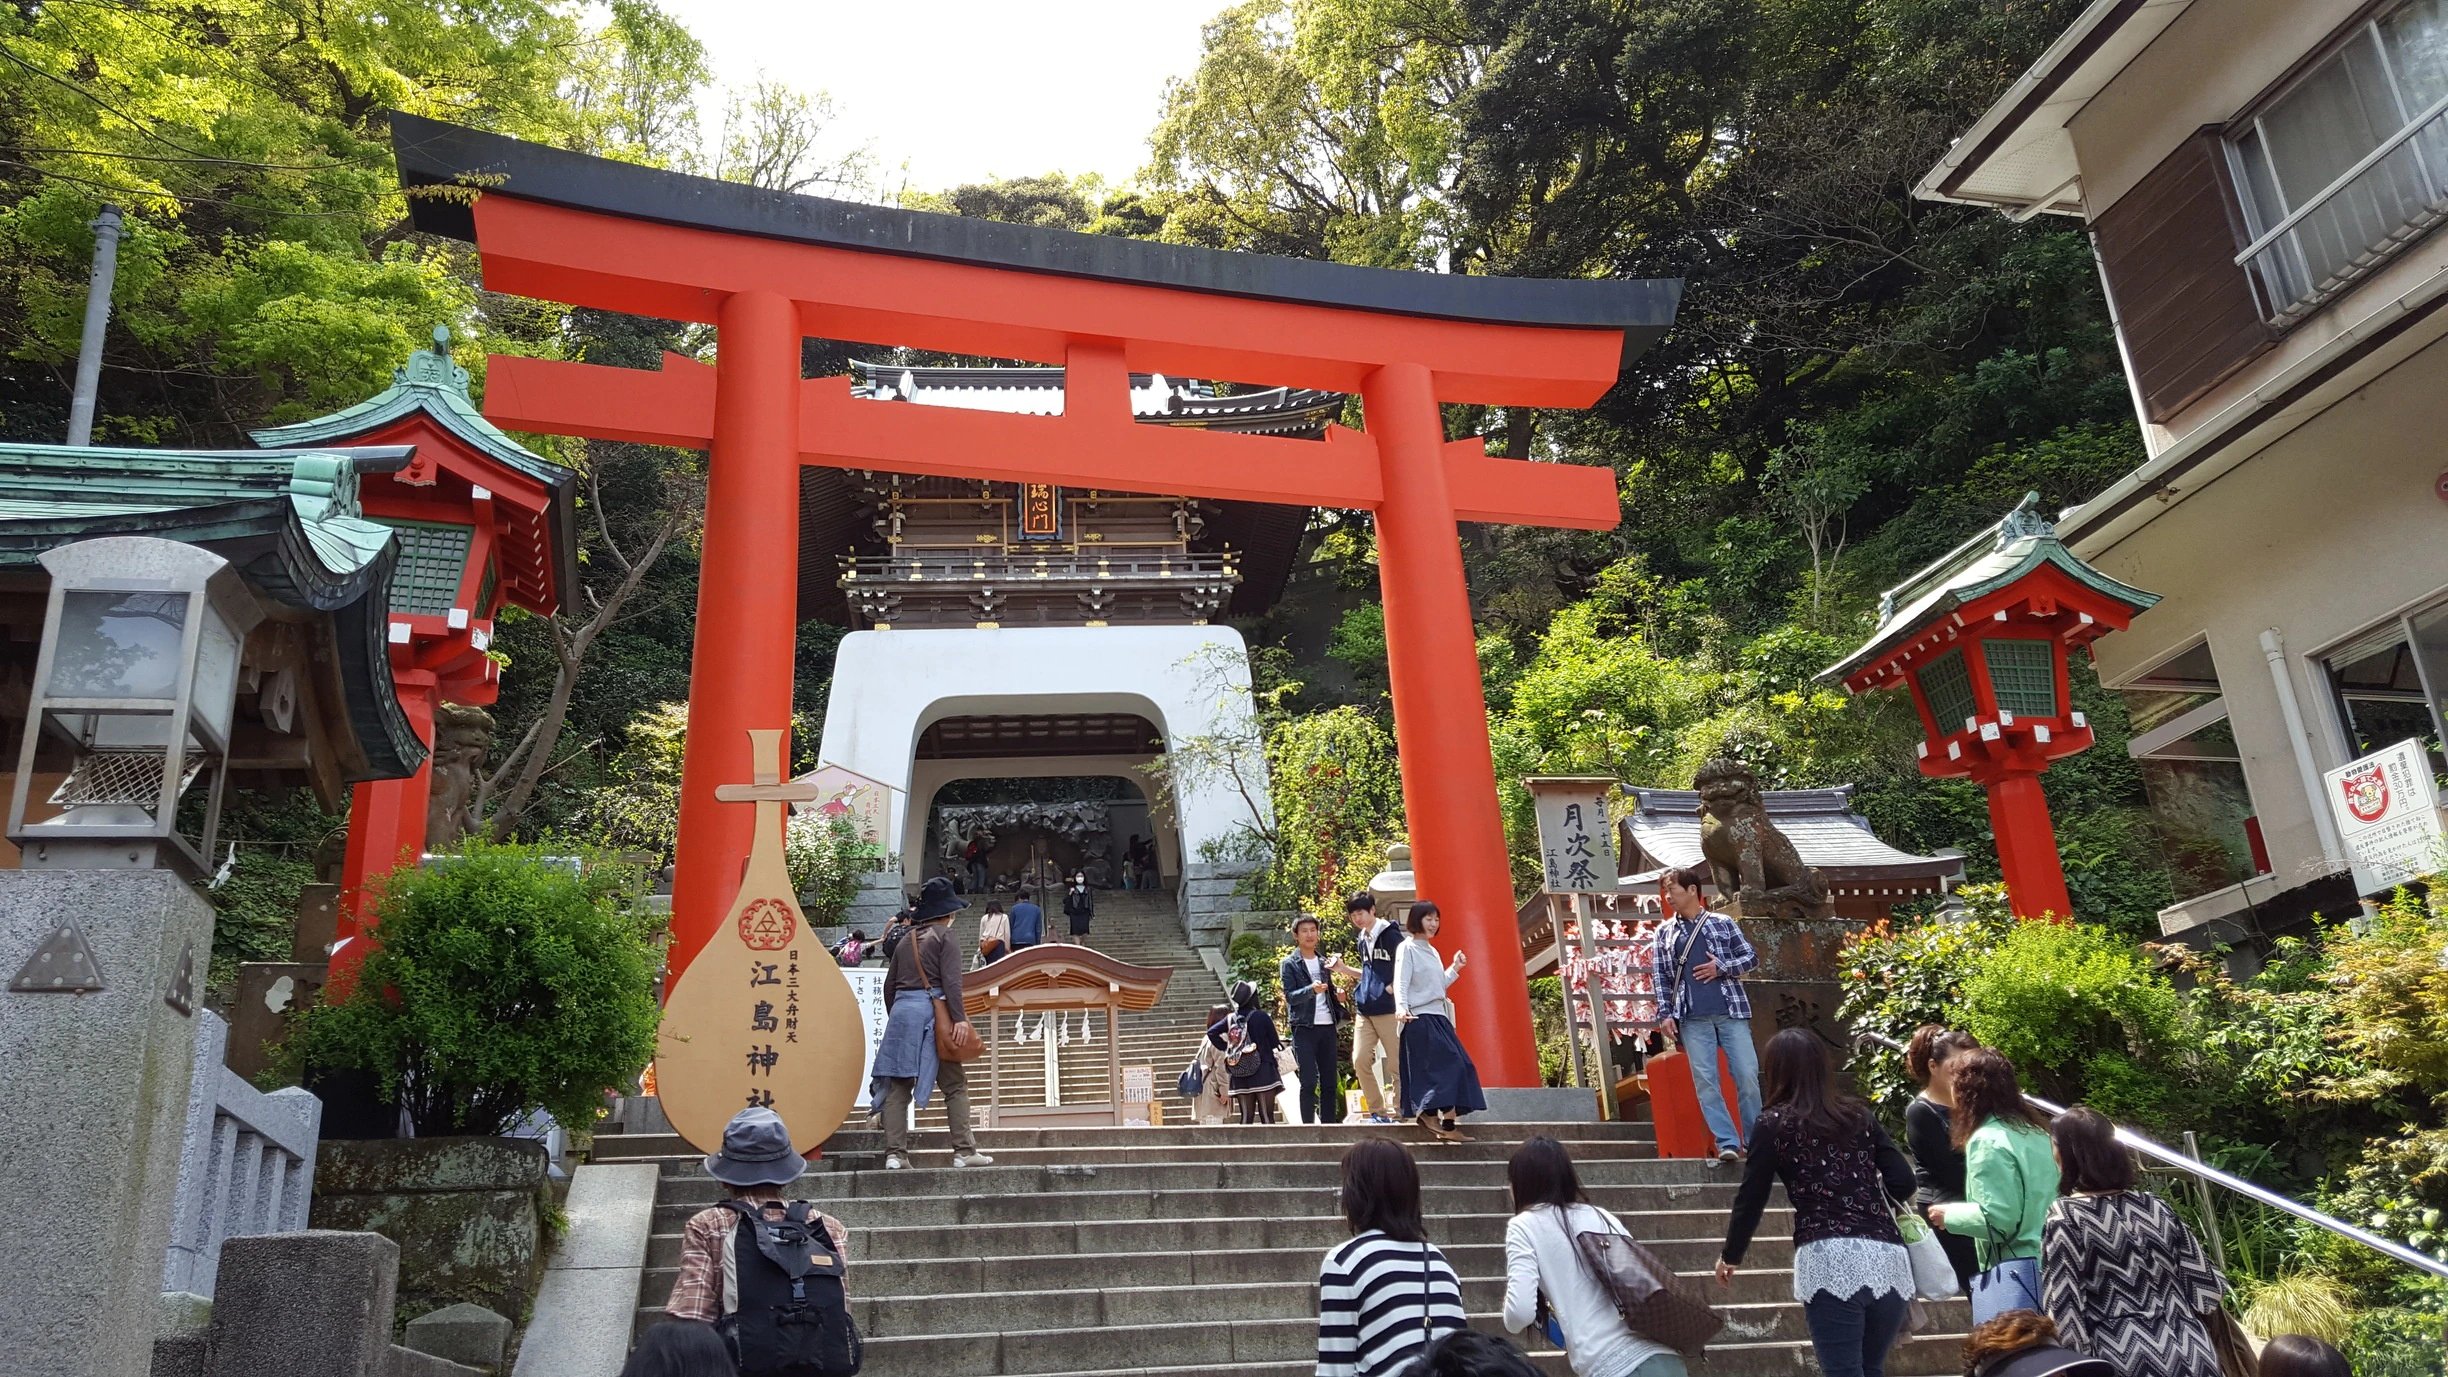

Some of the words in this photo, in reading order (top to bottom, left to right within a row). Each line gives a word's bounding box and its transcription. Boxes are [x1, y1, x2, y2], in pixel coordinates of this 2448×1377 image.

[1030, 484, 1050, 530] 瑞心門
[1546, 849, 1562, 888] 江島神社
[1563, 803, 1600, 890] 月次祭
[785, 950, 800, 1044] 日本三大弁財天
[856, 976, 865, 1005] 下さい
[746, 961, 782, 1112] 江島神社
